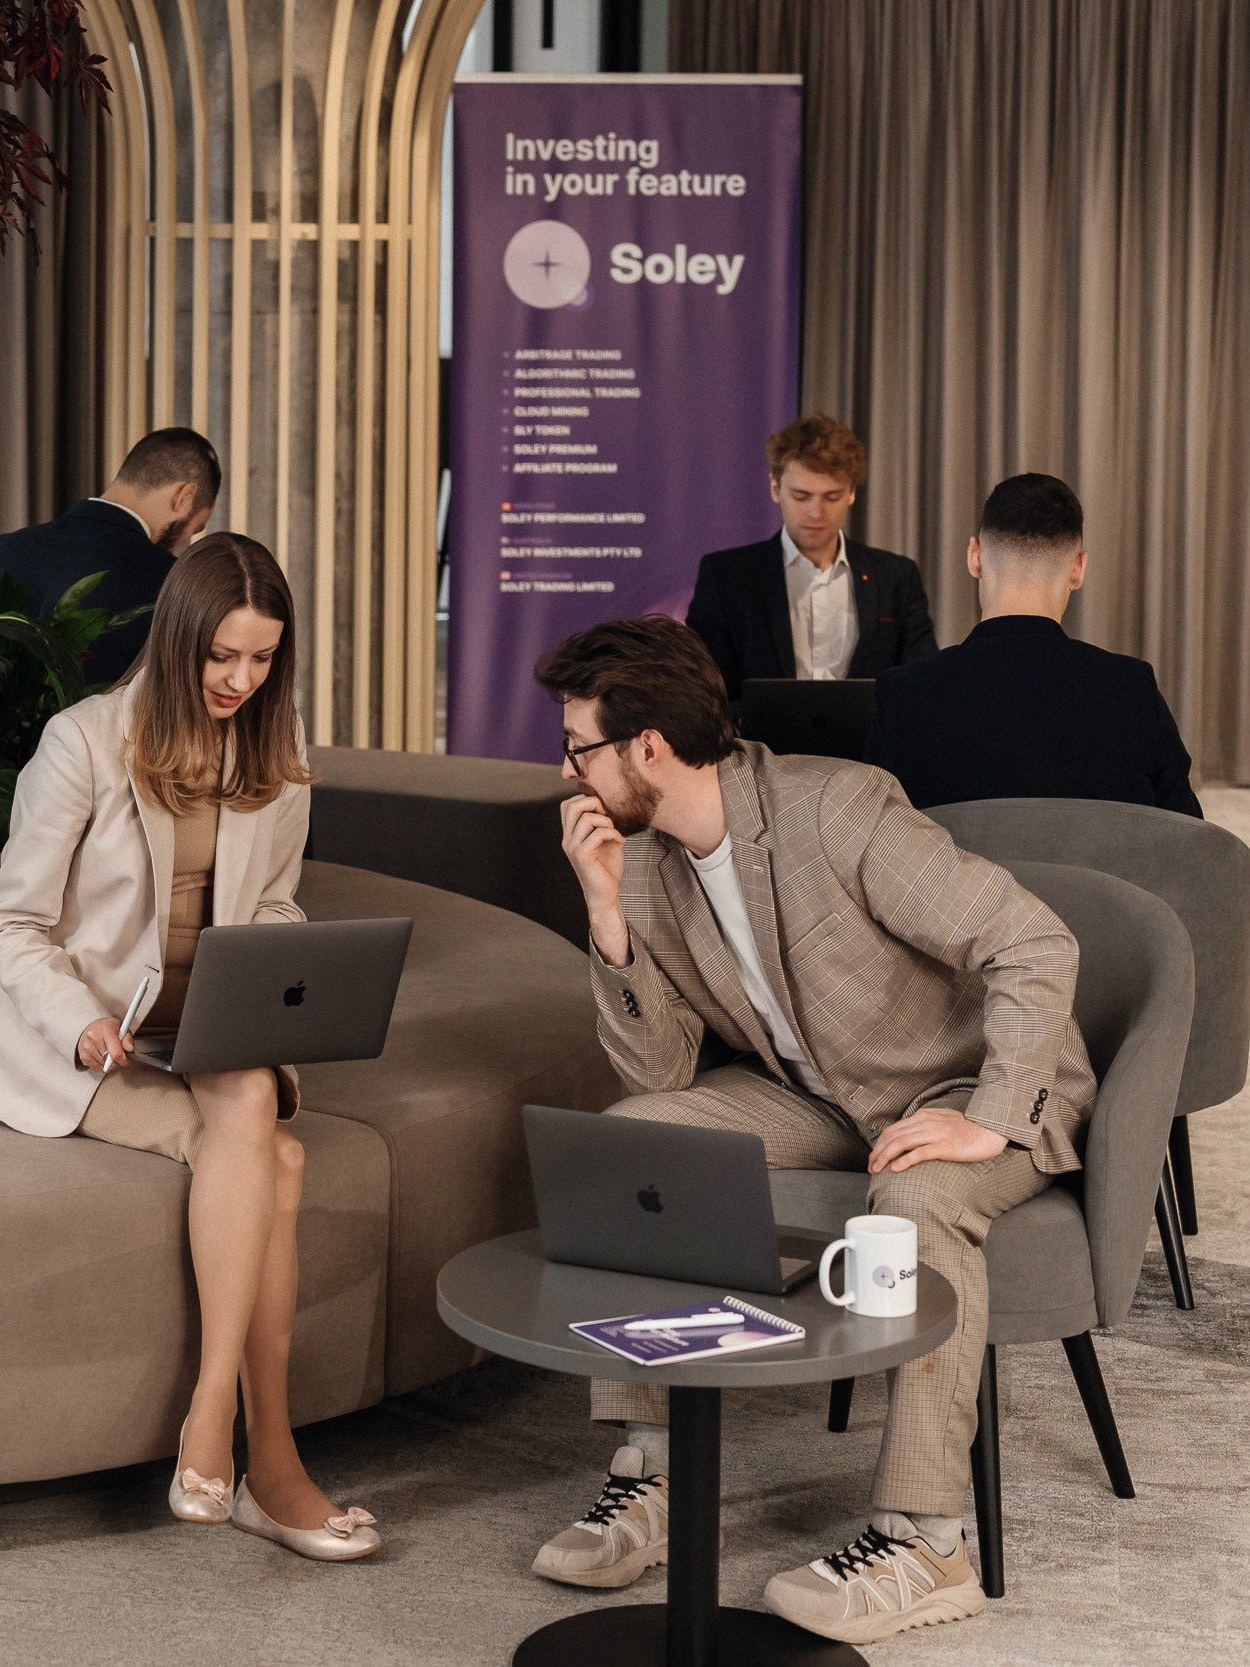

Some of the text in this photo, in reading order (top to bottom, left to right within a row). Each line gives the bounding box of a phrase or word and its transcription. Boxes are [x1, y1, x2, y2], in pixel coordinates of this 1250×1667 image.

[505, 131, 660, 168] Investing
[505, 166, 747, 202] in your feature
[609, 242, 746, 295] Soley
[514, 349, 622, 361] ARBITRAGE TRADING
[514, 368, 637, 380] ALGORITHMIC TRADING
[513, 387, 642, 399] PROFESSIONAL TRADING
[513, 406, 590, 418] CLOUD MINING
[513, 424, 571, 436] SLY TOKEN
[513, 443, 598, 455] SOLEY PREMIUM
[513, 462, 618, 474] AFFILIATE PROGRAM
[501, 512, 646, 524] SOLEY PERFORMANCE LIMITED
[500, 546, 532, 558] SOLEY
[533, 546, 601, 558] INVESTMENTS
[623, 546, 643, 558] LTD
[500, 581, 616, 593] SOLEY TRADING LIMITED
